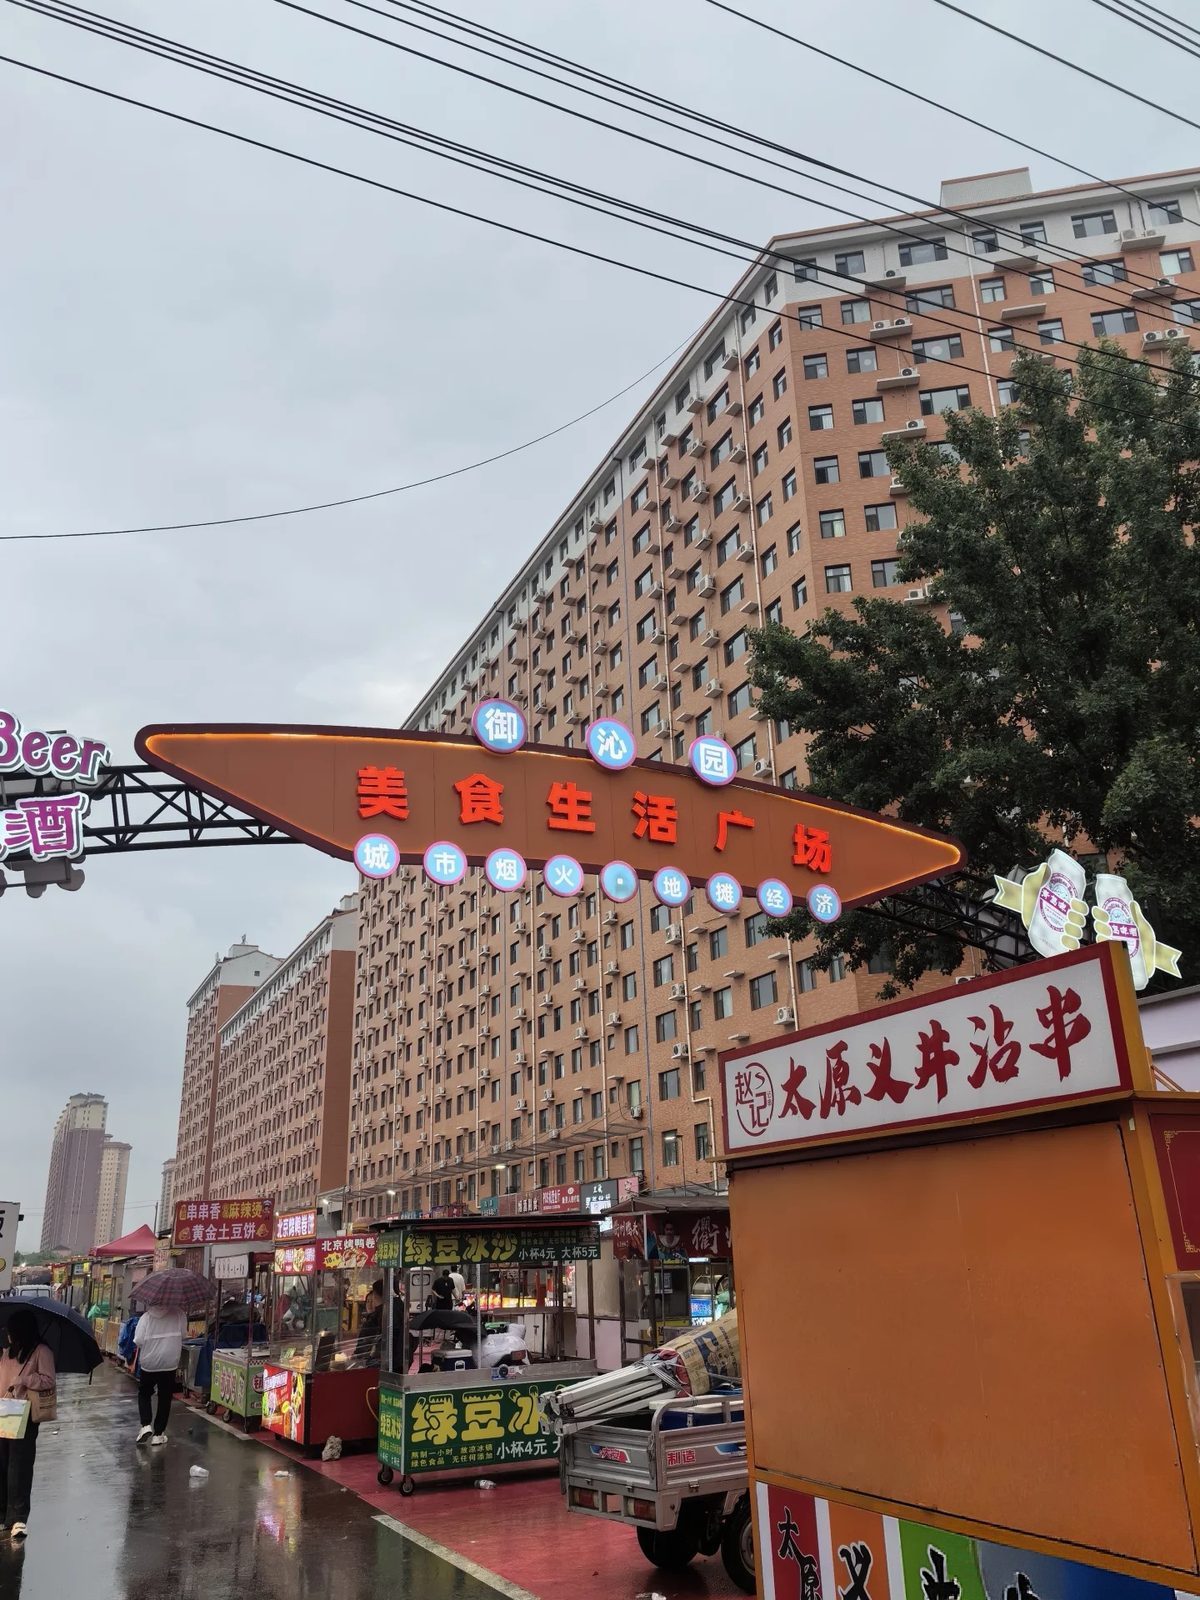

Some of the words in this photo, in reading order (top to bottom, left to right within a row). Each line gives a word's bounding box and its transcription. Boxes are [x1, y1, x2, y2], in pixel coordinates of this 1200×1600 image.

[0, 711, 106, 777] Beer
[485, 705, 728, 778] 御沁园
[0, 795, 81, 855] 酒
[357, 766, 833, 874] 美食生活广场
[735, 1071, 770, 1129] 赵记
[778, 985, 1091, 1120] 太原义井沾串
[187, 1203, 221, 1221] 串串香
[191, 1222, 256, 1241] 黄金土豆饼
[321, 1237, 378, 1252] 北京烤鸭卷
[404, 1232, 518, 1265] 绿豆冰沙
[519, 1247, 555, 1261] 小杯4元
[561, 1245, 598, 1259] 大杯5元
[411, 1385, 551, 1446] 绿豆冰
[496, 1439, 548, 1460] 小杯4元
[667, 1450, 696, 1466] 制造
